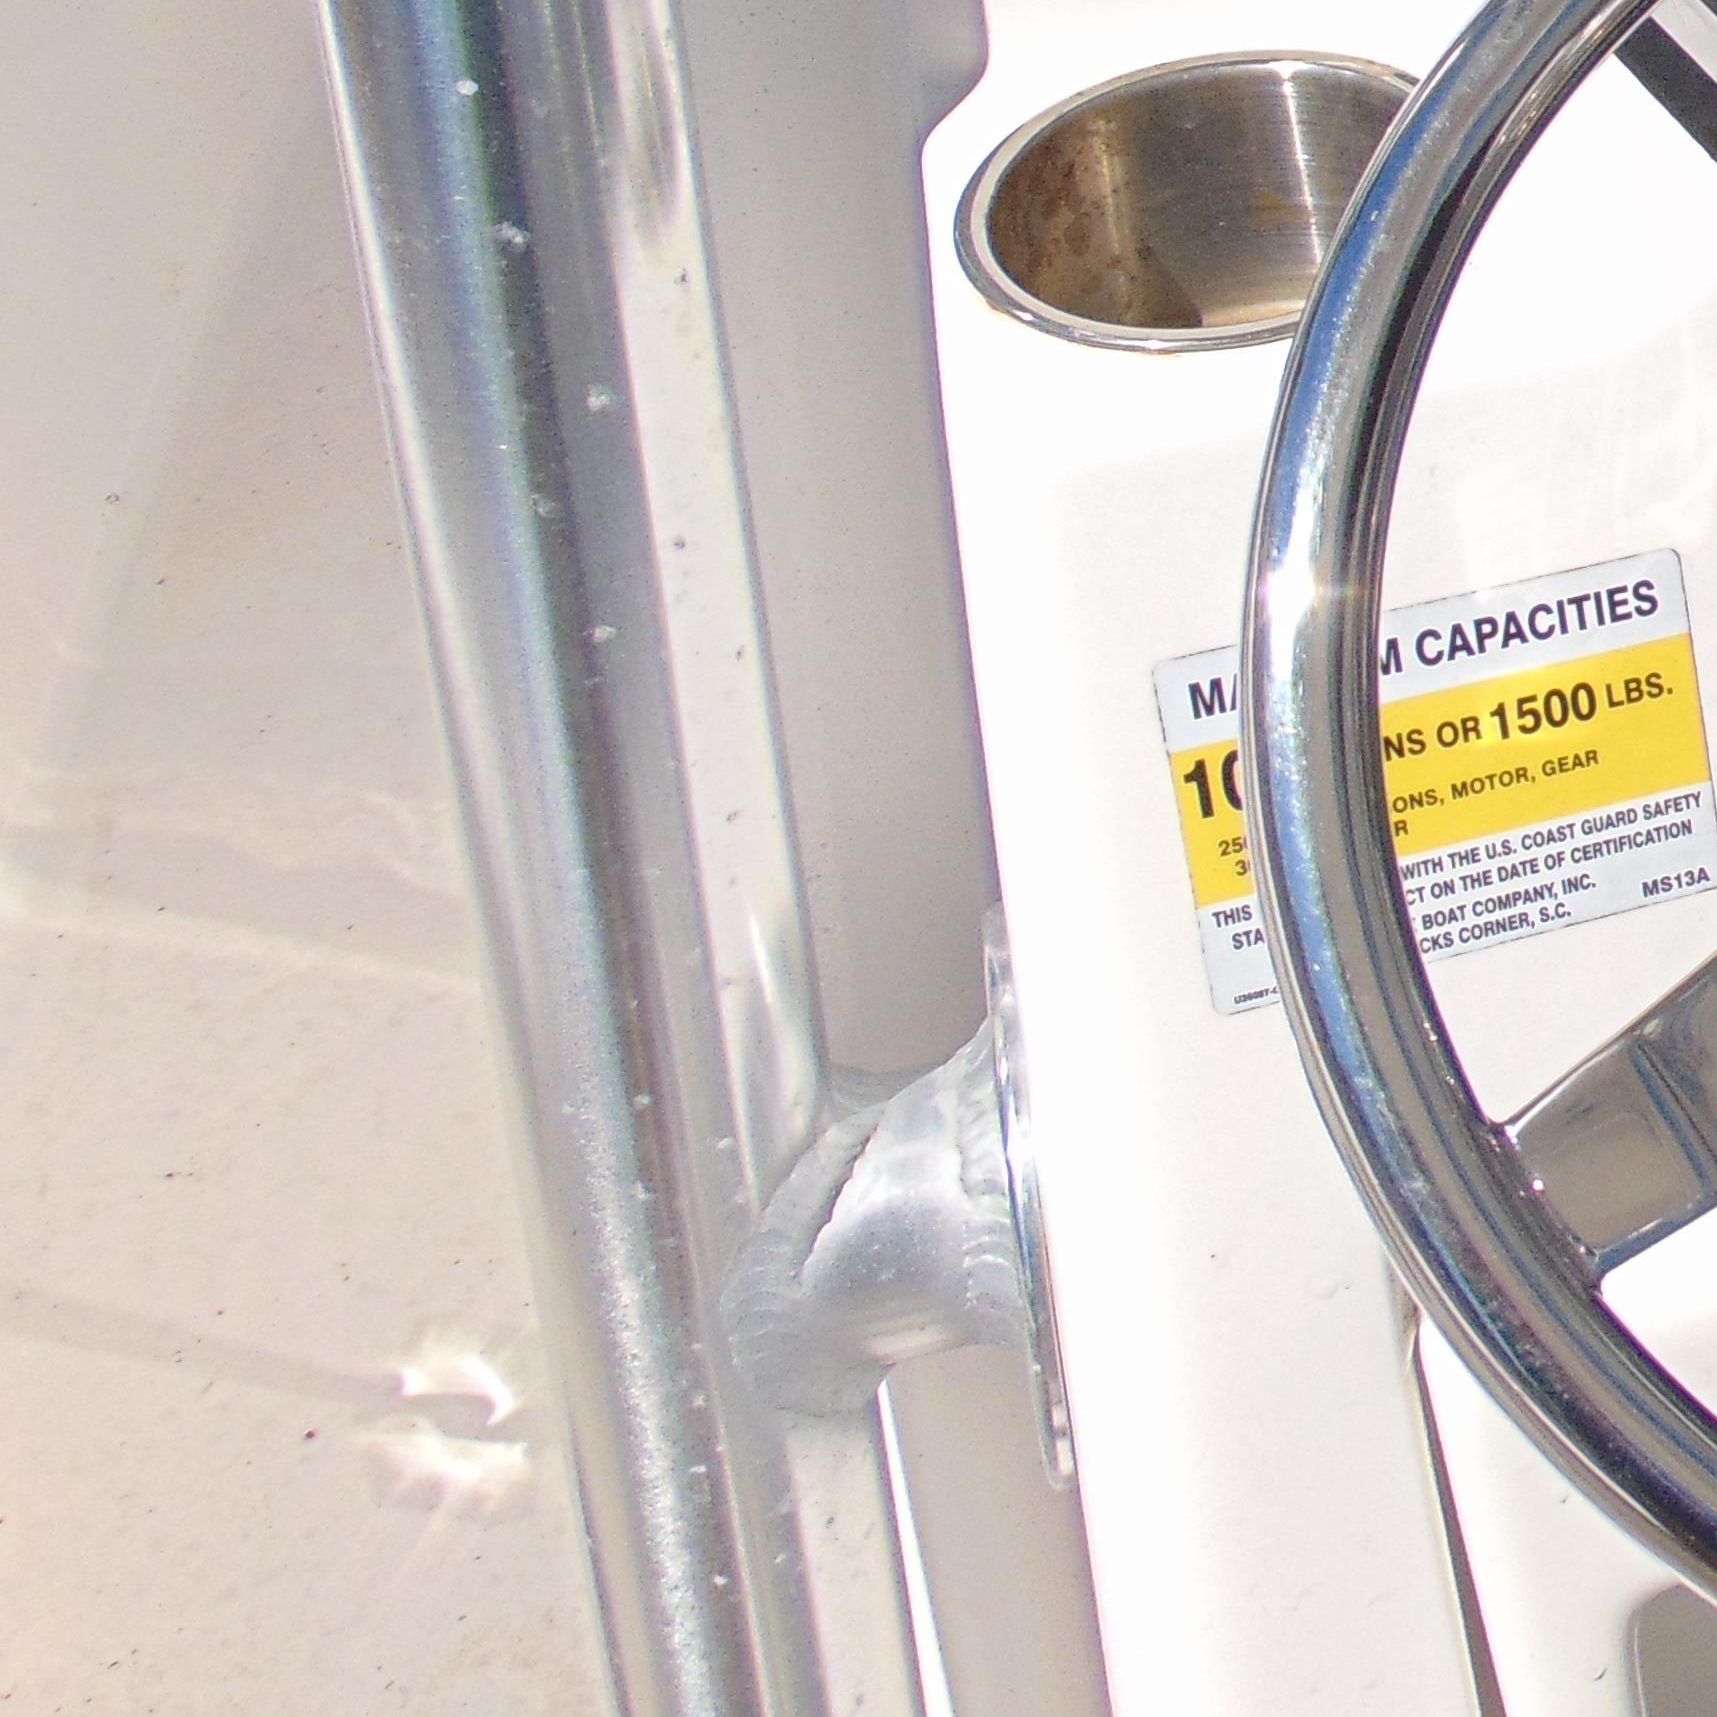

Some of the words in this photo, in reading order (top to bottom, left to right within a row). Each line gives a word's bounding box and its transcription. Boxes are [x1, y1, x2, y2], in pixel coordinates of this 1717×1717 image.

[1415, 580, 1658, 666] CAPACITIES
[1436, 716, 1483, 749] OR
[1490, 682, 1598, 740] 1500
[1606, 672, 1673, 709] LBS.
[1451, 766, 1536, 801] MOTOR,
[1542, 750, 1599, 777] GEAR
[1401, 856, 1443, 881] WITH
[1449, 847, 1481, 870] THE
[1486, 838, 1517, 860] U.S.
[1521, 823, 1577, 851] COAST
[1581, 807, 1637, 836] GUARD
[1643, 791, 1702, 821] SAFETY
[1430, 881, 1459, 901] ON
[1462, 870, 1494, 893] THE
[1498, 858, 1540, 883] DATE
[1544, 851, 1566, 871] OF
[1571, 819, 1693, 864] CERTIFICATION
[1423, 906, 1467, 931] BOAT
[1472, 884, 1558, 918] COMPANY,
[1562, 873, 1597, 895] INC.
[1642, 867, 1711, 898] MS13A
[1212, 905, 1252, 928] THIS
[1458, 912, 1536, 945] CORNER,
[1539, 902, 1572, 924] S.C.
